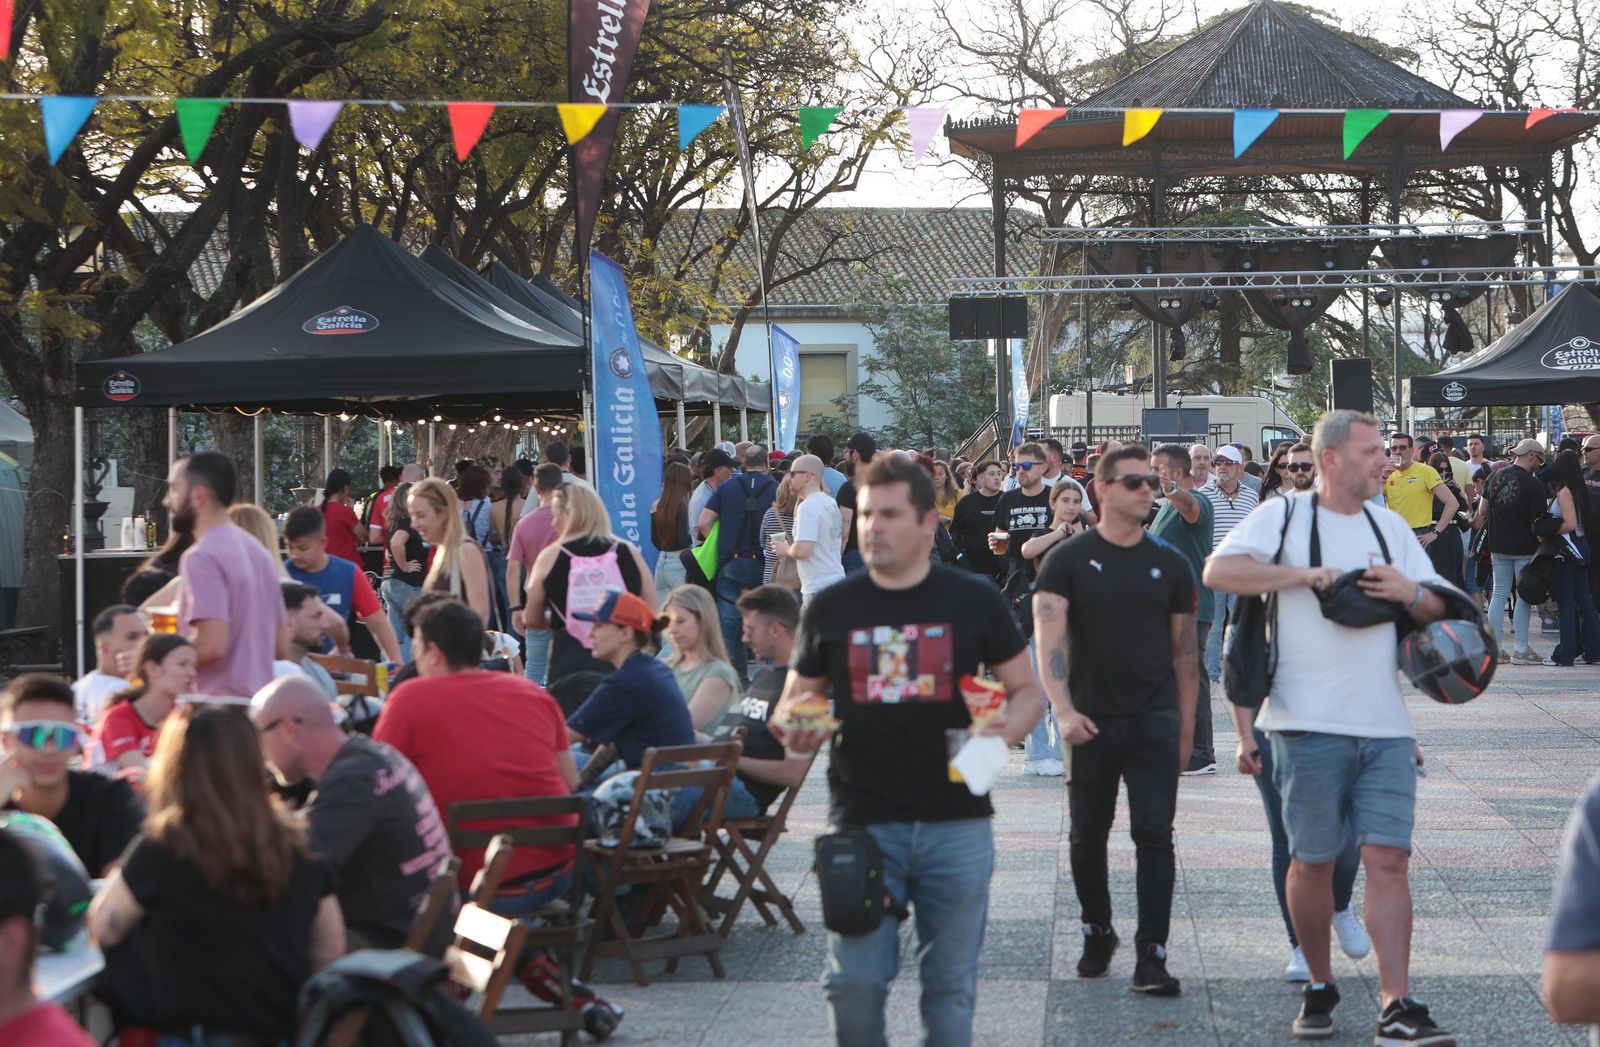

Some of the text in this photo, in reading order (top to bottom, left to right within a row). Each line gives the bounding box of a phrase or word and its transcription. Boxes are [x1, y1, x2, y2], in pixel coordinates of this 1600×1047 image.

[316, 314, 368, 325] Estrella
[316, 322, 363, 330] Galicia
[1554, 348, 1600, 360] Estrell
[1556, 356, 1600, 366] Galici
[610, 386, 636, 486] Galicia
[1428, 443, 1439, 453] 93
[618, 491, 642, 553] ella
